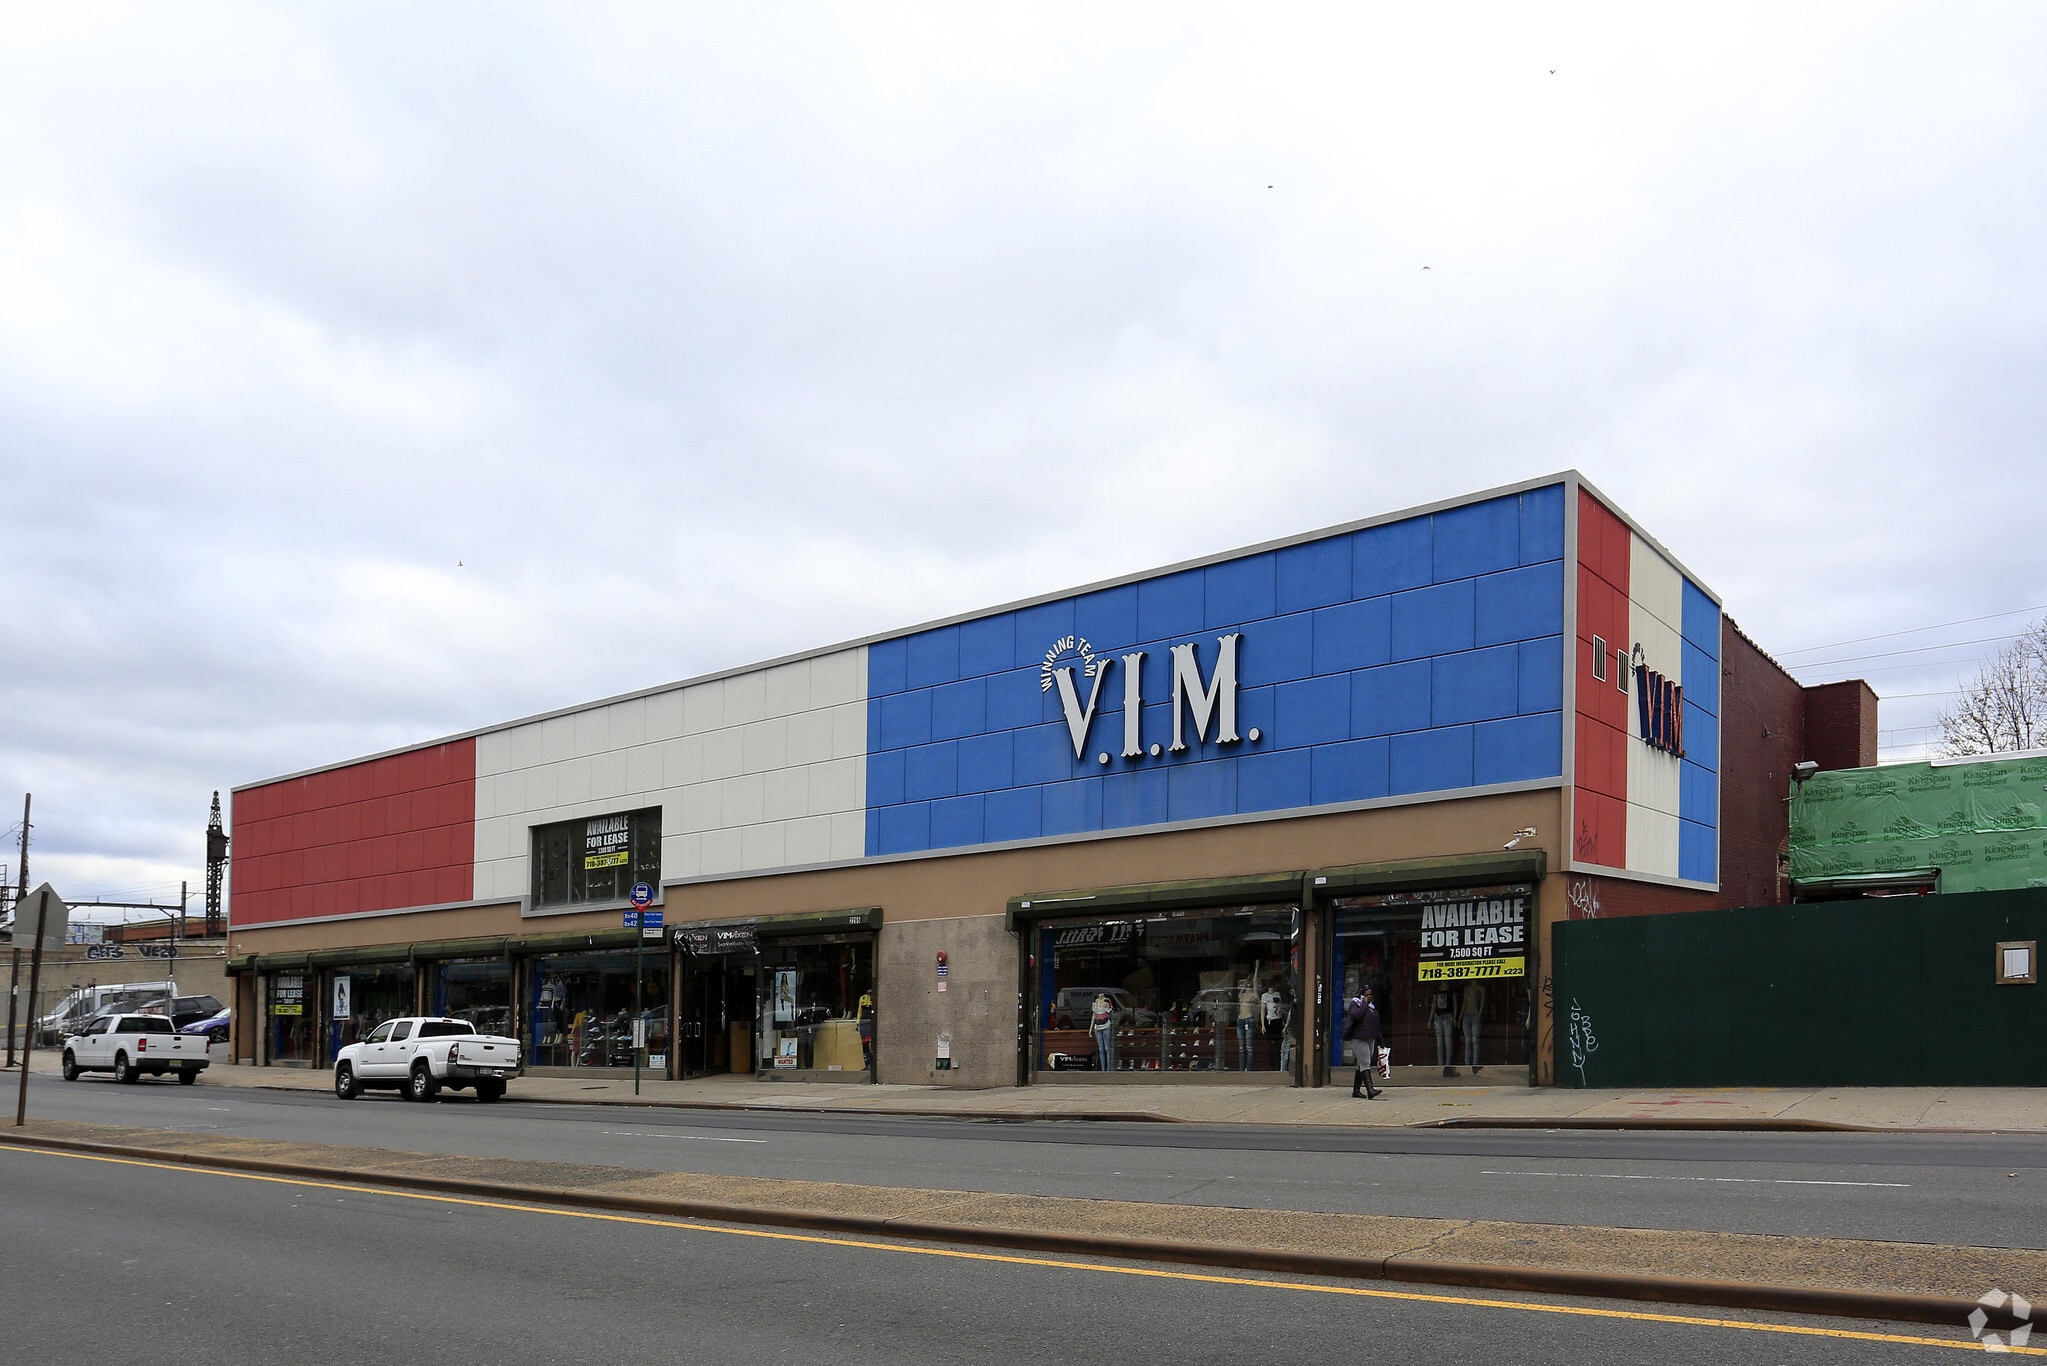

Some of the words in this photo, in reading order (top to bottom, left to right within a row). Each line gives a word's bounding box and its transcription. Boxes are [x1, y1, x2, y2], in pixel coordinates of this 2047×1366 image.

[1041, 635, 1075, 693] WINNING
[1076, 637, 1096, 677] TEAM
[1052, 632, 1261, 764] V.I.M.
[1908, 775, 1951, 786] Kingspan
[1963, 769, 2007, 780] Kingspan
[1855, 780, 1896, 791] Kingspan
[1804, 786, 1843, 798] Kingspan
[586, 815, 629, 837] AVAILABLE
[586, 836, 602, 848] FOR
[603, 831, 629, 846] LEASE
[1929, 849, 1972, 860] Kingspan
[1985, 843, 2030, 855] Kingspan
[1875, 855, 1916, 866] Kingspan
[1421, 898, 1524, 929] AVAILABLE
[1421, 930, 1459, 948] FOR
[1464, 925, 1524, 946] LEASE
[1449, 947, 1471, 958] 7,500
[1471, 947, 1483, 957] SQ
[1483, 946, 1493, 956] FT
[1421, 965, 1501, 979] 718-387-7777
[287, 989, 303, 998] LEASE
